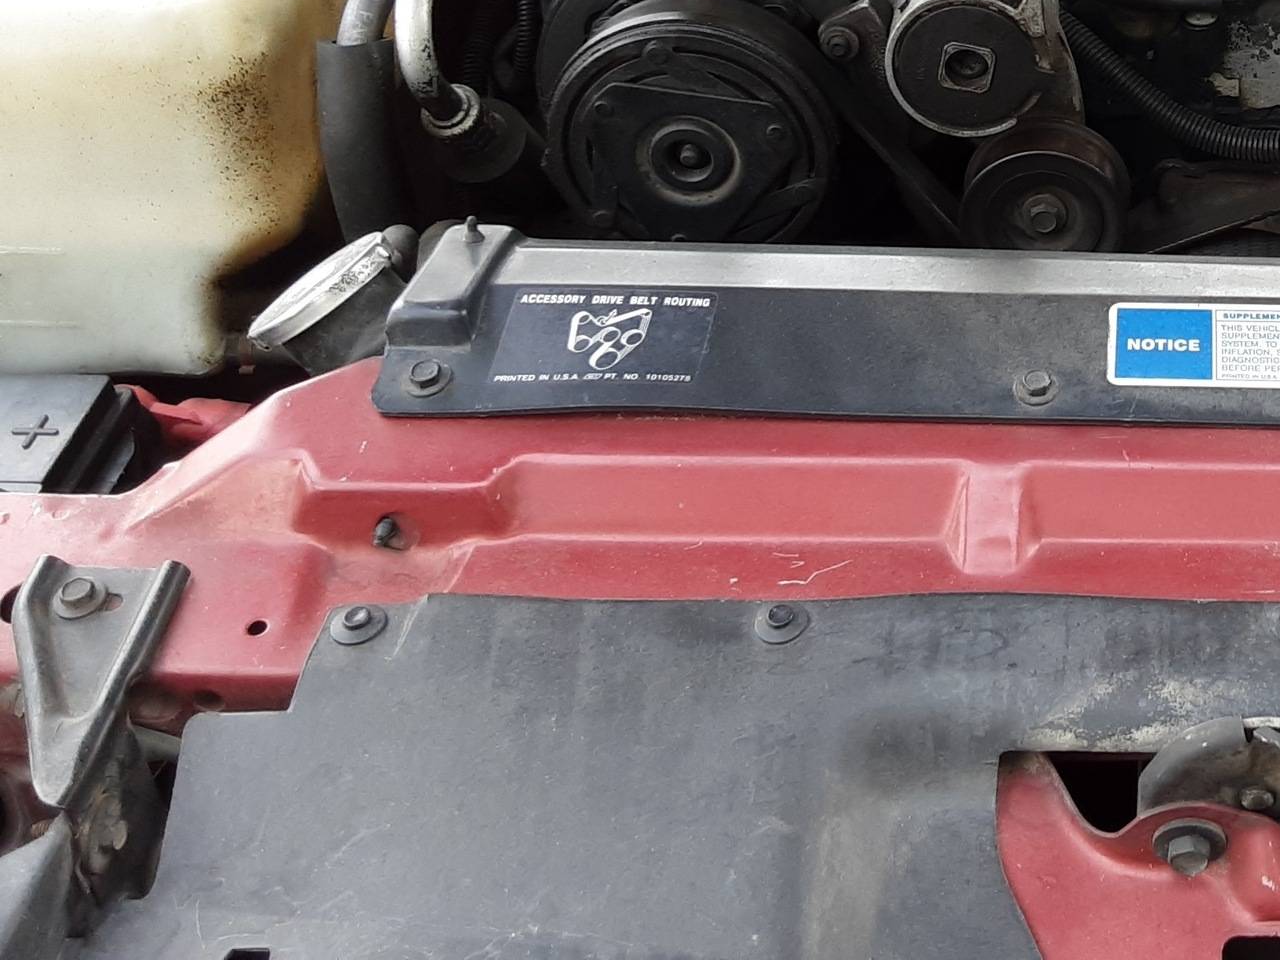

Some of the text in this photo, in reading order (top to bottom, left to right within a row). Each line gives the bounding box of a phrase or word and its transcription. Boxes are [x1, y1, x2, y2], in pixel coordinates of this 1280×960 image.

[520, 294, 711, 307] ACCESSORY DRIVE BELT ROUTING
[1221, 324, 1243, 332] THIS
[1127, 338, 1201, 352] NOTICE
[1221, 356, 1280, 364] DIAGNOSTIC
[1221, 364, 1261, 372] BEFORE
[493, 374, 535, 382] PRINTED
[538, 373, 550, 381] IN
